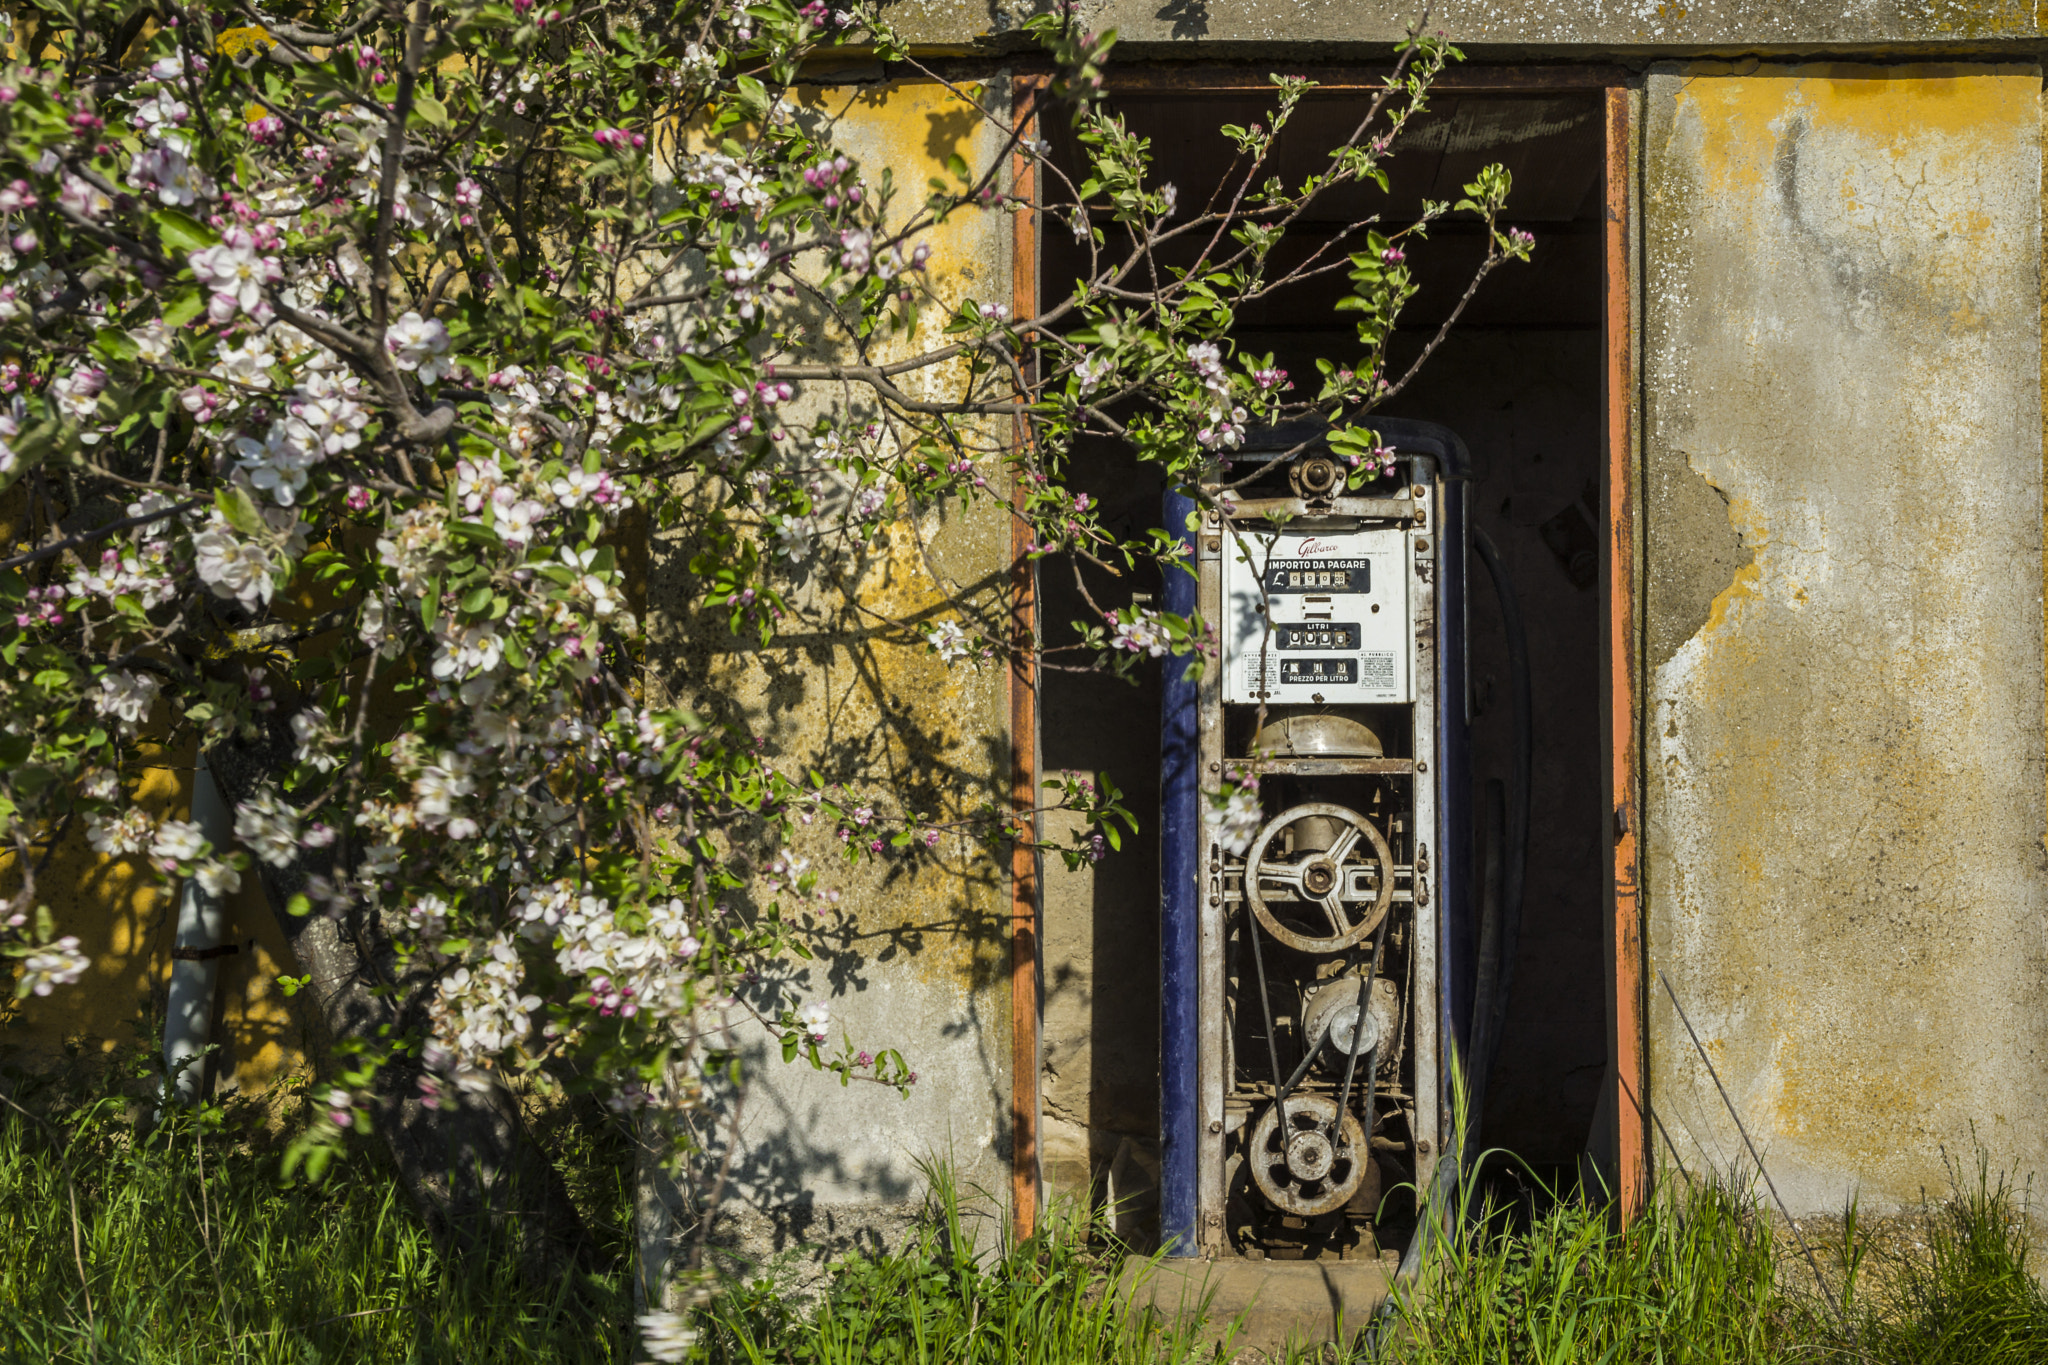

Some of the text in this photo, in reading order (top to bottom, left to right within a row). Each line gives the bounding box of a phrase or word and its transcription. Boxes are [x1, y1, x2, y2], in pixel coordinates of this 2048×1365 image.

[1298, 537, 1338, 558] Gilbarco
[1269, 560, 1366, 570] IMPORTO DA PAGARE
